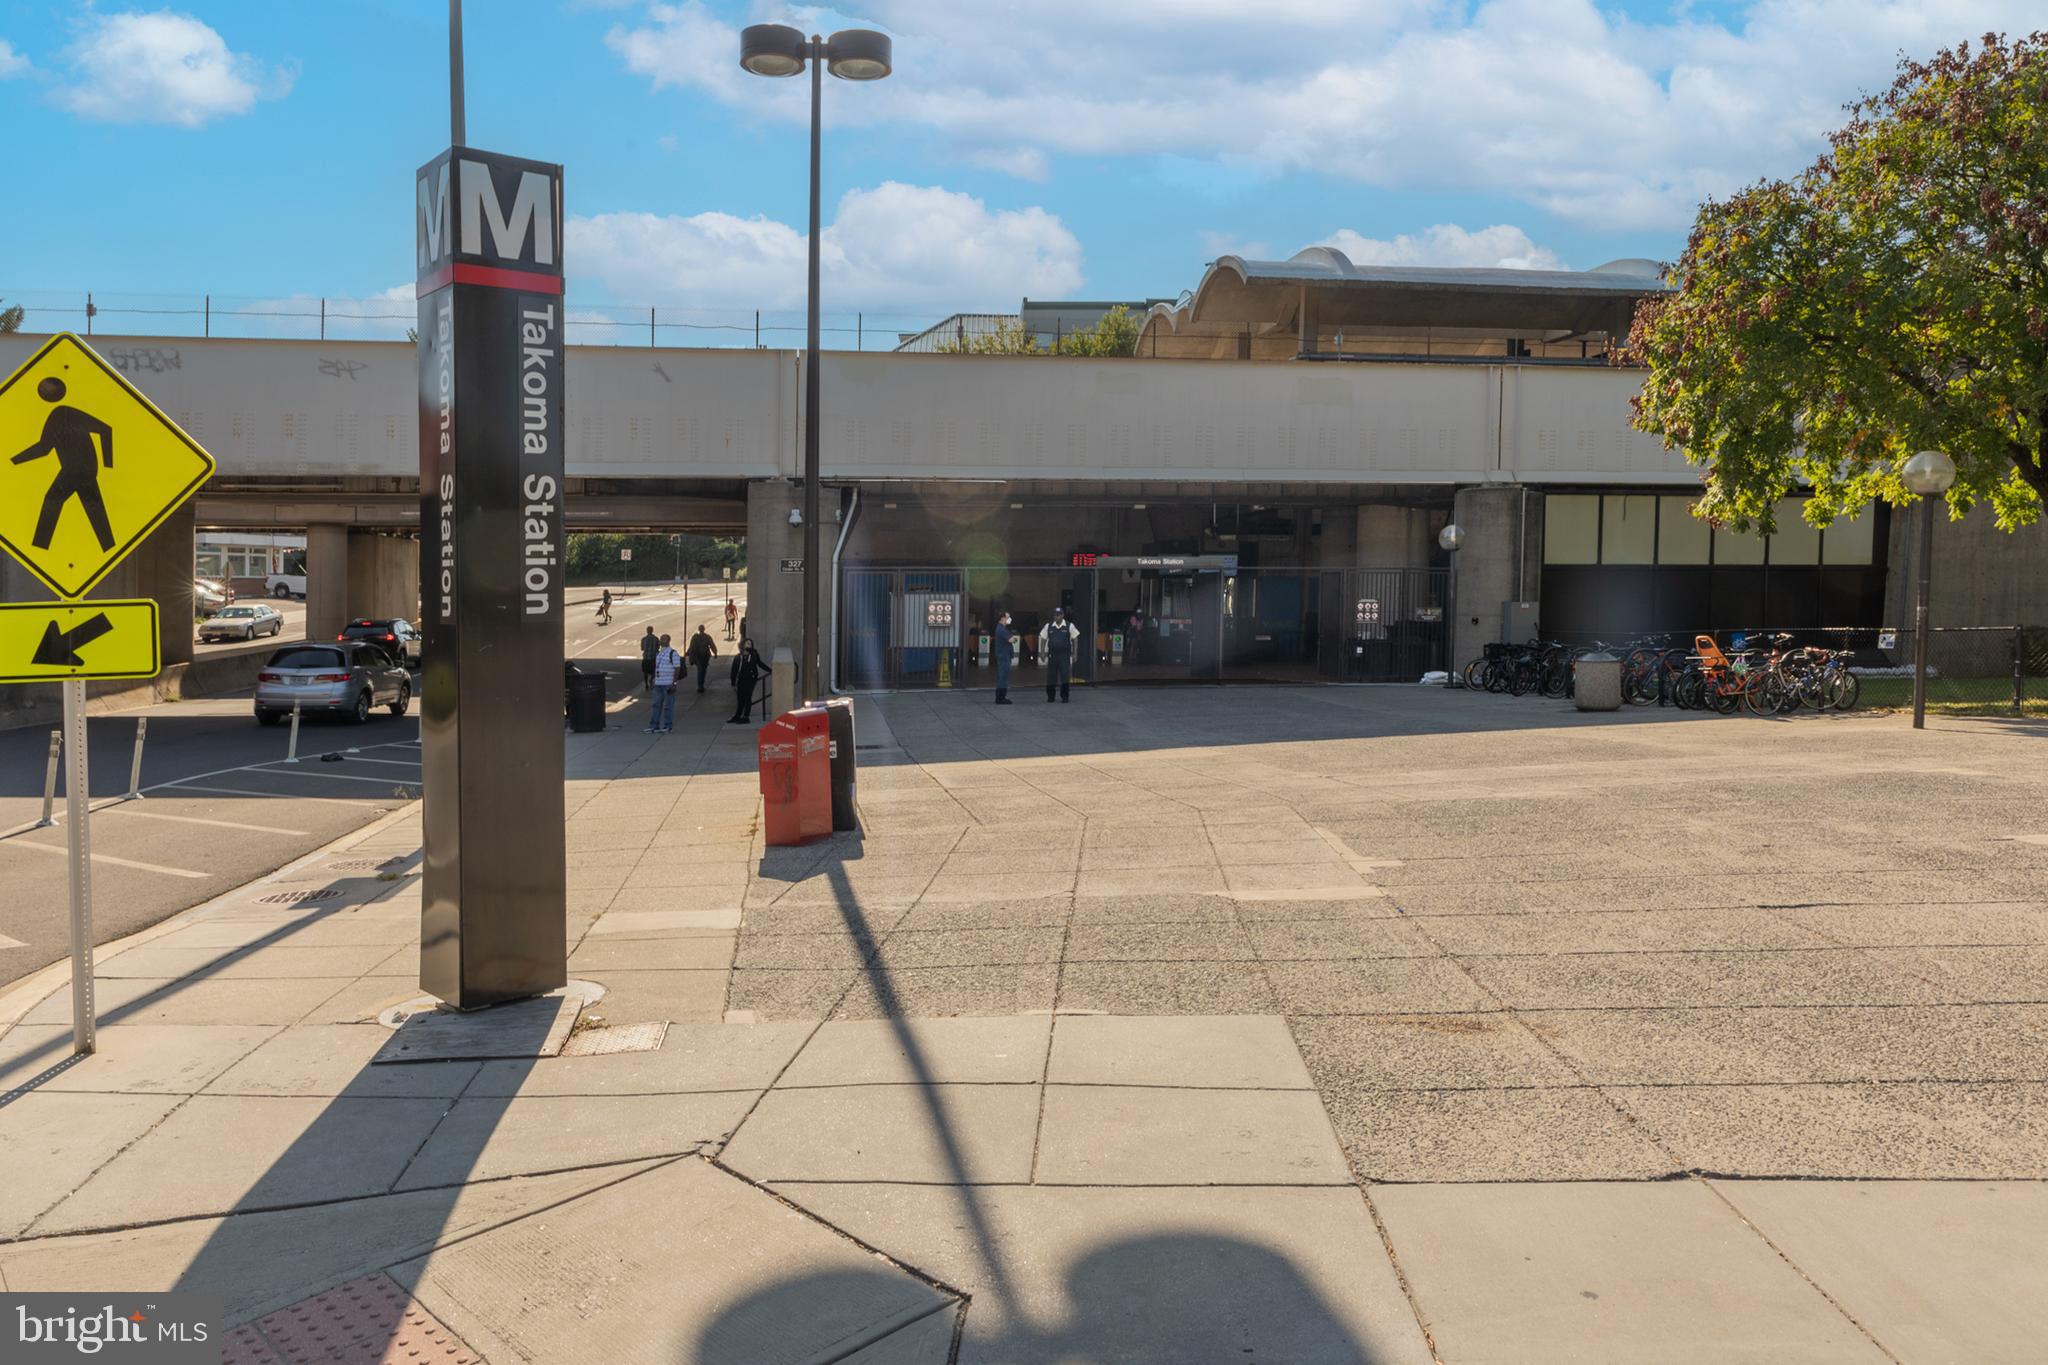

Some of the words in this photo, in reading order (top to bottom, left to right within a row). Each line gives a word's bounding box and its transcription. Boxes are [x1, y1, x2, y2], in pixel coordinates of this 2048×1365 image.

[418, 161, 451, 269] M
[459, 158, 553, 265] M
[438, 295, 453, 455] Takoma
[522, 304, 554, 454] Takoma
[441, 474, 454, 617] Station
[523, 474, 556, 615] Station
[1137, 557, 1161, 565] Takoma
[1162, 557, 1184, 565] Station
